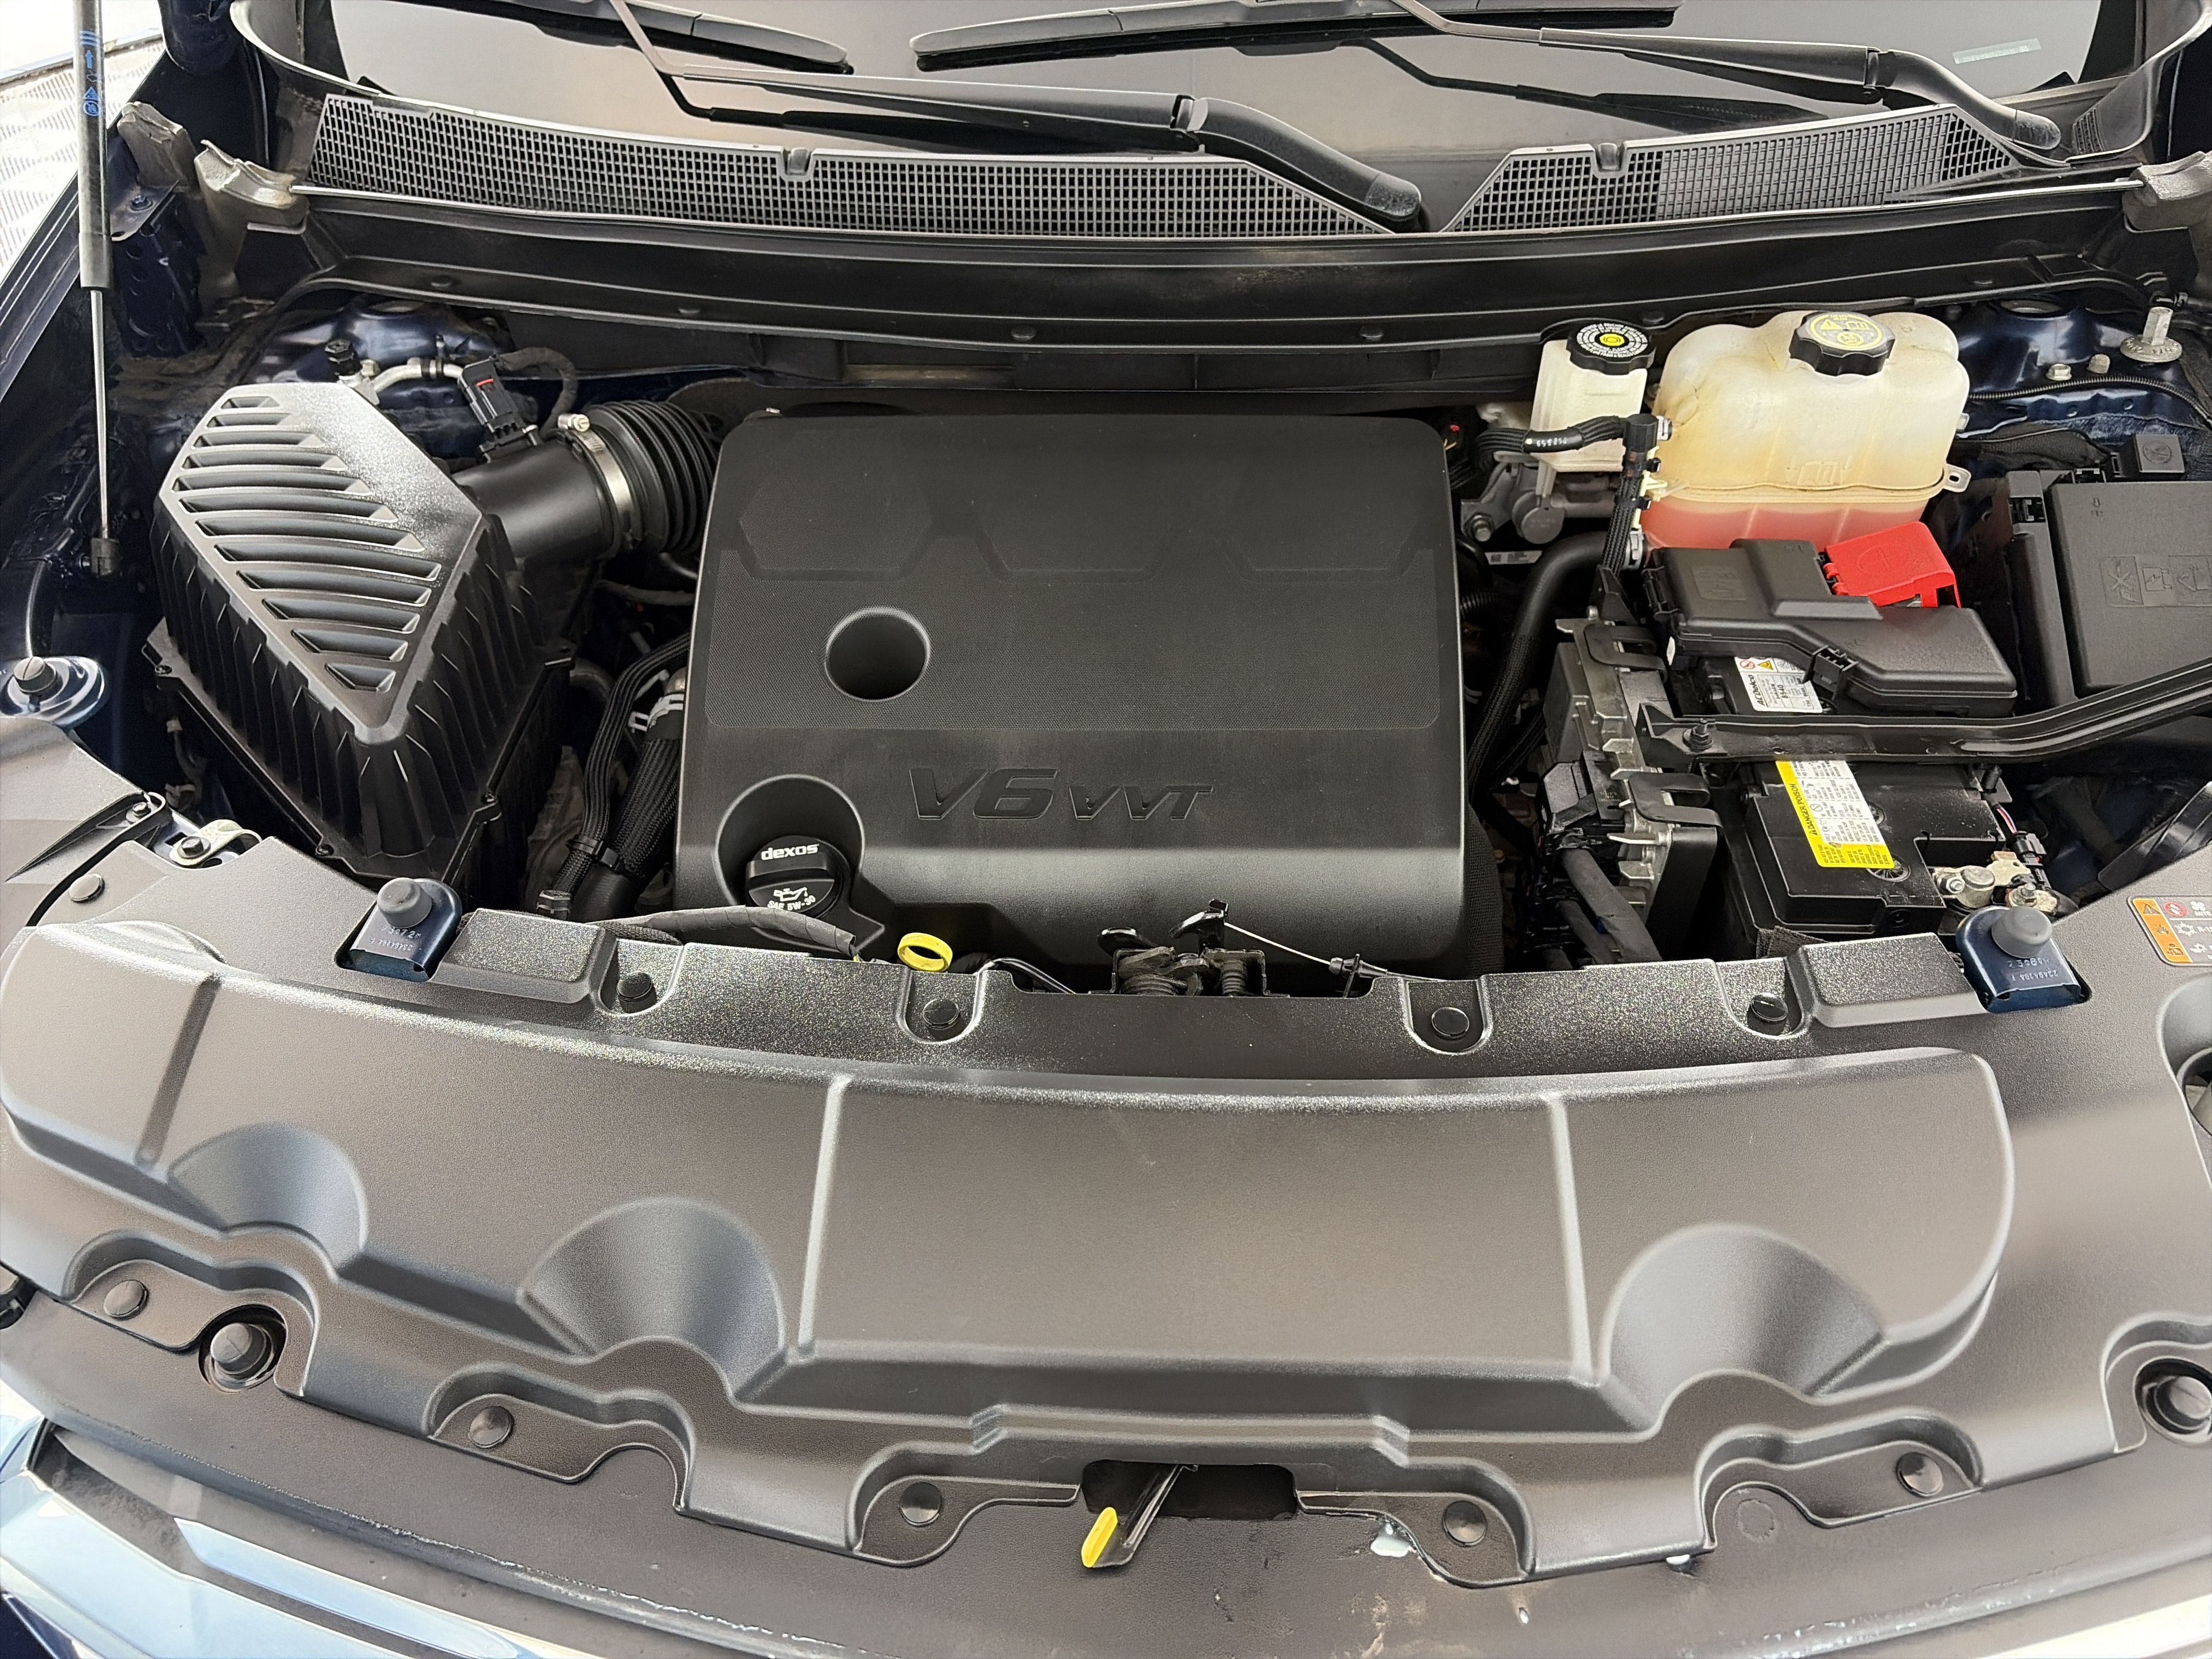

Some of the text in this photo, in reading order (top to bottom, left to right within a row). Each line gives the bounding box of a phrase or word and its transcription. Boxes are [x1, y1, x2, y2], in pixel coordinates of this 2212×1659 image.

[1748, 674, 1765, 706] ACDelco
[909, 768, 1214, 821] V6 VVT
[761, 844, 819, 860] dexos
[768, 895, 816, 911] SAE 5W-30
